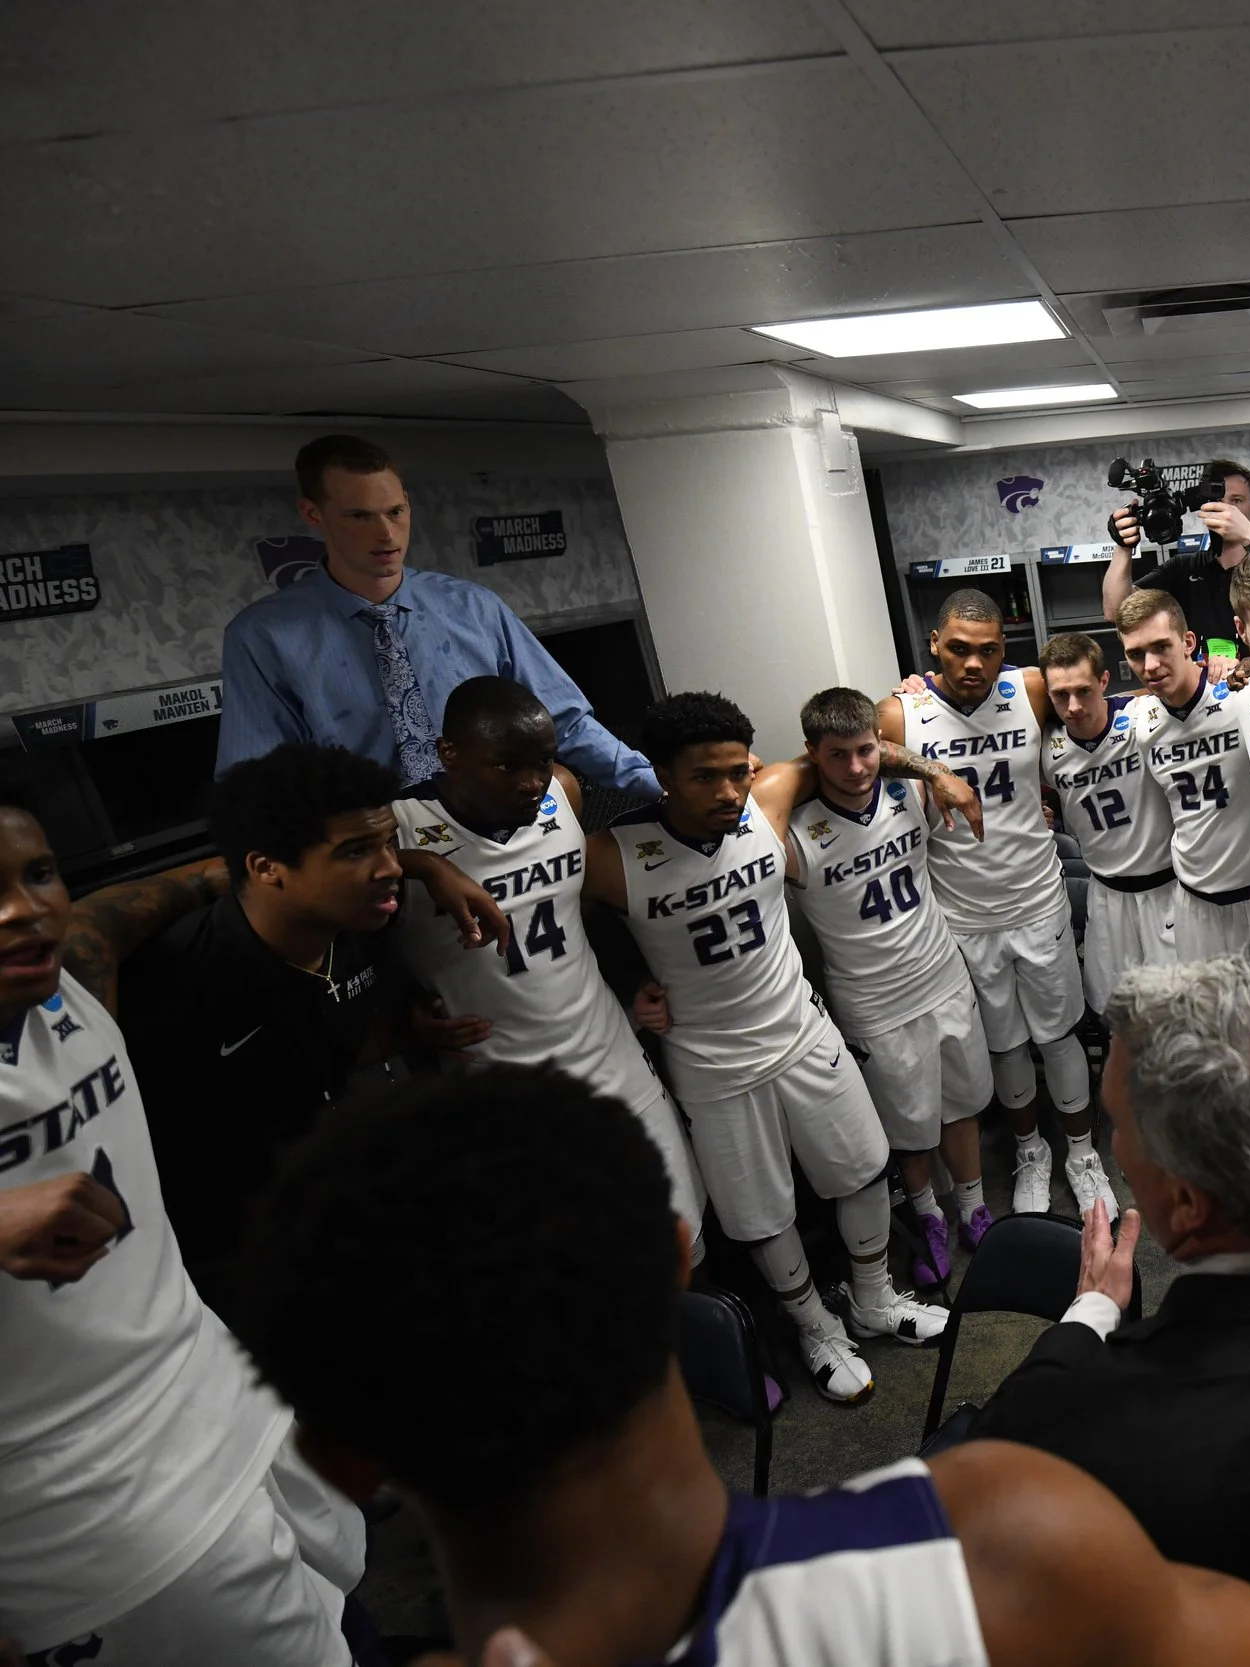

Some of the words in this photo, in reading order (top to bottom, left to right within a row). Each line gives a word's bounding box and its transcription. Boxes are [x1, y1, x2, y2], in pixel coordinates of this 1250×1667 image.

[1162, 464, 1205, 481] MARCH
[492, 516, 541, 537] MARCH
[503, 532, 566, 555] MADNESS
[968, 558, 989, 566] JAMES
[991, 557, 1005, 570] 21
[1102, 545, 1115, 553] MIK
[0, 577, 98, 611] DNESS
[153, 700, 211, 722] MAWIEN
[158, 688, 207, 708] MAKOL
[34, 717, 63, 730] MARCH
[41, 722, 78, 736] MADNESS
[921, 728, 1027, 760] K-STATE
[1151, 728, 1240, 766] K-STATE
[1054, 751, 1141, 789] K-STATE
[1170, 765, 1230, 811] 24
[1080, 788, 1133, 831] 12
[823, 825, 922, 887] K-STATE
[481, 848, 583, 901] STATE
[647, 852, 777, 919] K-STATE
[859, 864, 921, 924] 40
[503, 898, 568, 977] 14
[686, 898, 767, 967] 23
[0, 1053, 126, 1173] STATE
